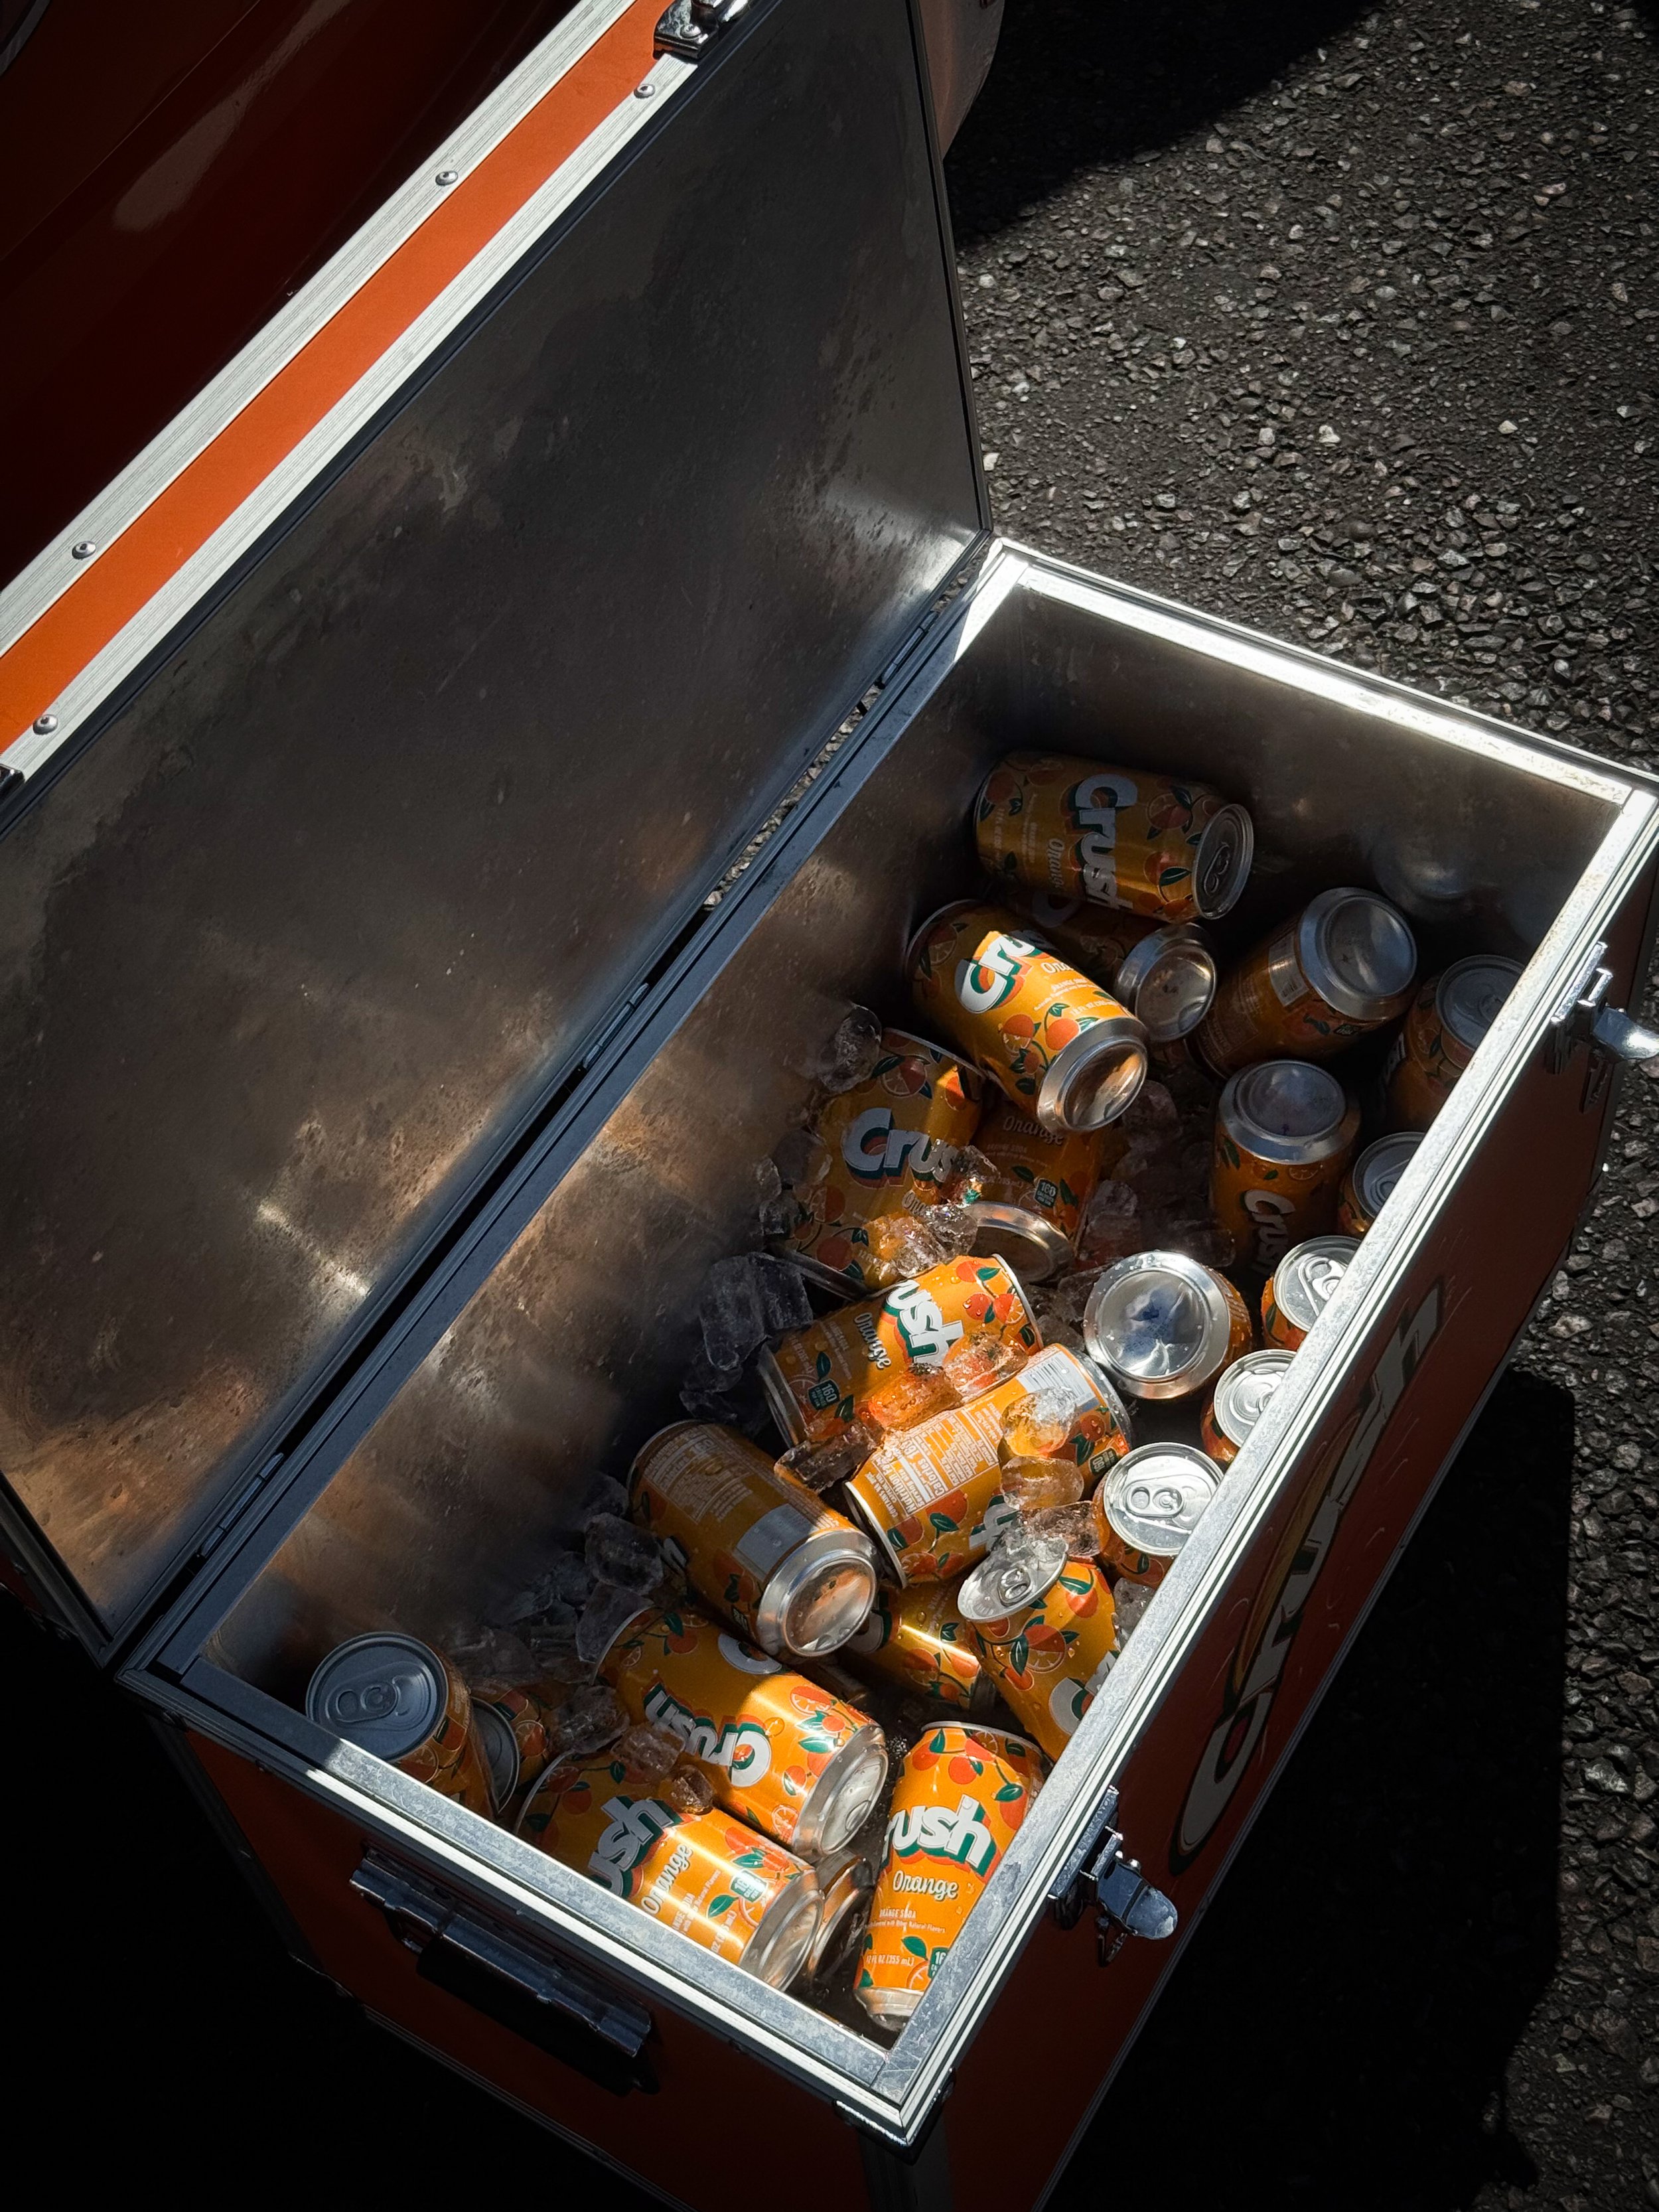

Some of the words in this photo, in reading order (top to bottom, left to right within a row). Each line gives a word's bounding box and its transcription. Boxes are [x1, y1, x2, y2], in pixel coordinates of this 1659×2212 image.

[843, 1108, 960, 1182] Crus
[853, 1312, 891, 1369] Orange
[884, 1280, 964, 1366] ush
[820, 1382, 837, 1403] 160
[887, 1471, 916, 1514] Nutrition
[917, 1455, 944, 1498] Calories
[1090, 1455, 1107, 1473] 160
[1178, 1286, 1440, 1848] Crush
[645, 1691, 772, 1787] Crush
[588, 1796, 674, 1897] ush
[881, 1793, 991, 1868] rush
[642, 1842, 693, 1914] Orange
[893, 1870, 958, 1900] Orange
[934, 1951, 946, 1964] 16
